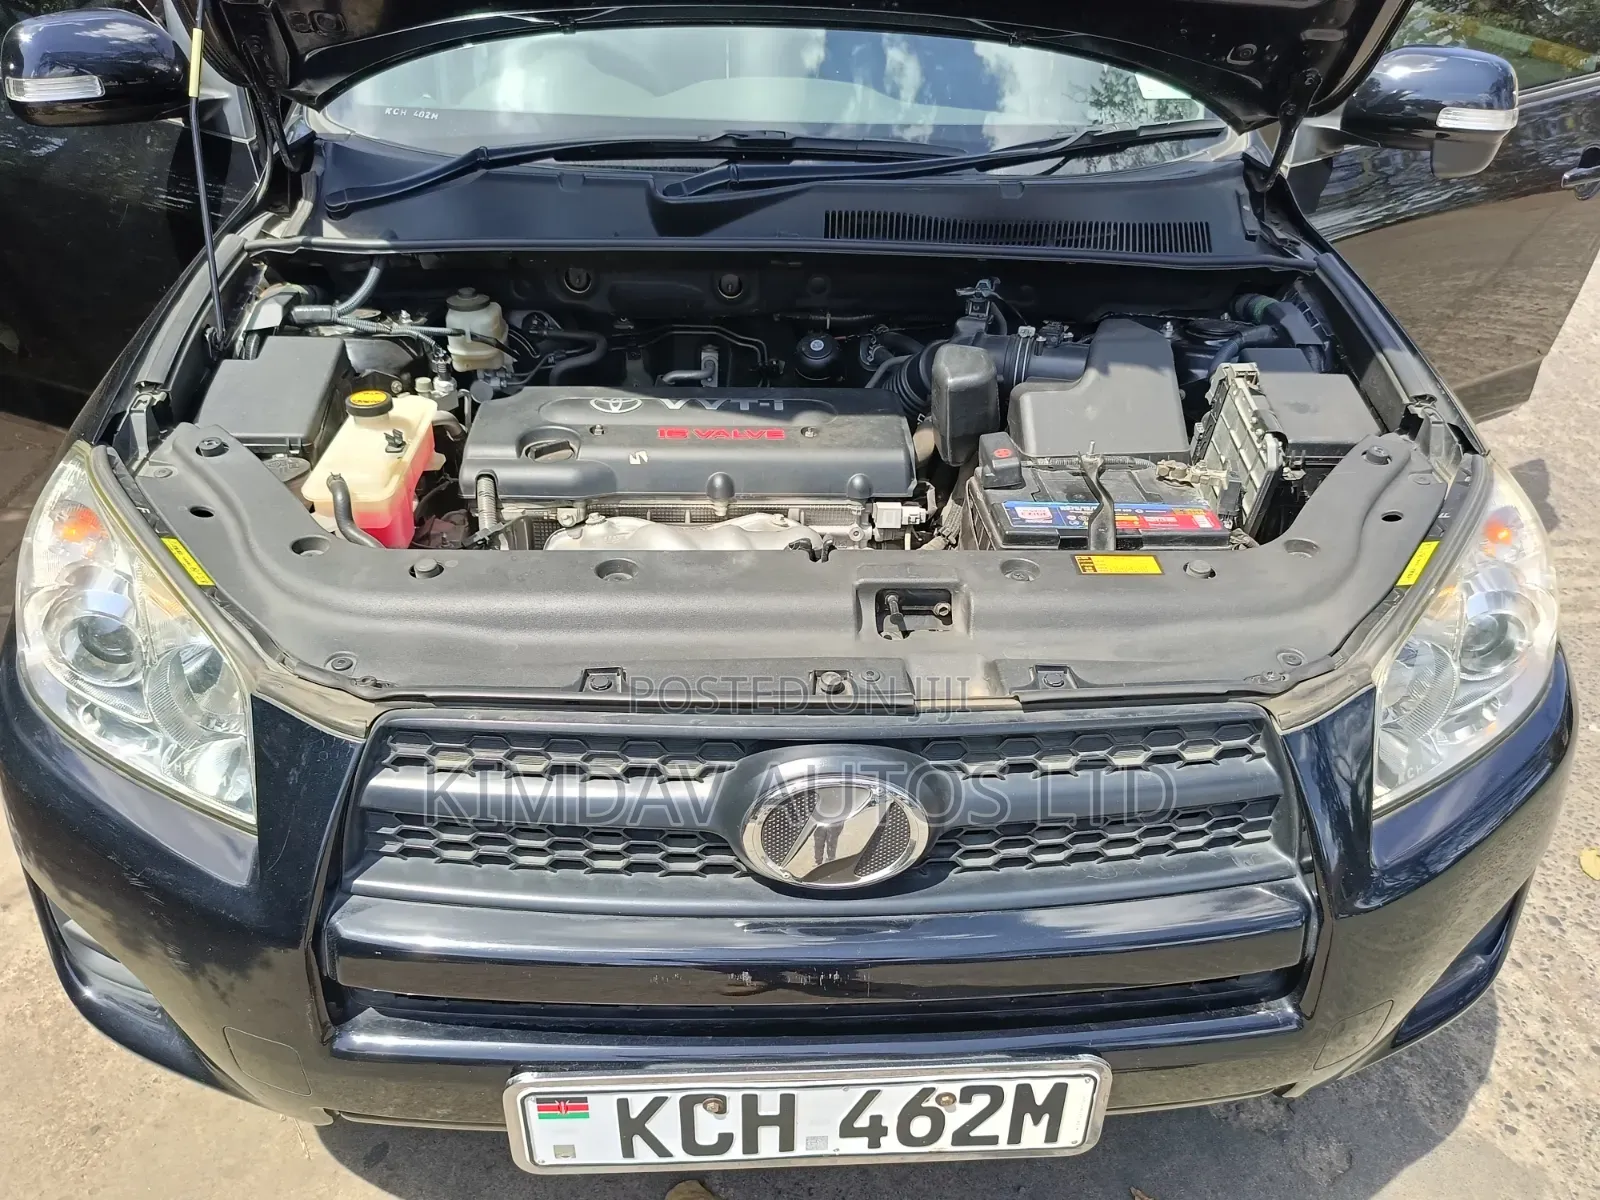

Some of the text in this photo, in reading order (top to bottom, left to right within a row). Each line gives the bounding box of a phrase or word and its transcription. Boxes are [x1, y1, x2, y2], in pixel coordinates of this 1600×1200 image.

[384, 107, 408, 116] KCH
[692, 427, 786, 441] VALVE
[616, 1093, 796, 1158] KCH
[838, 1082, 1069, 1149] 462M
